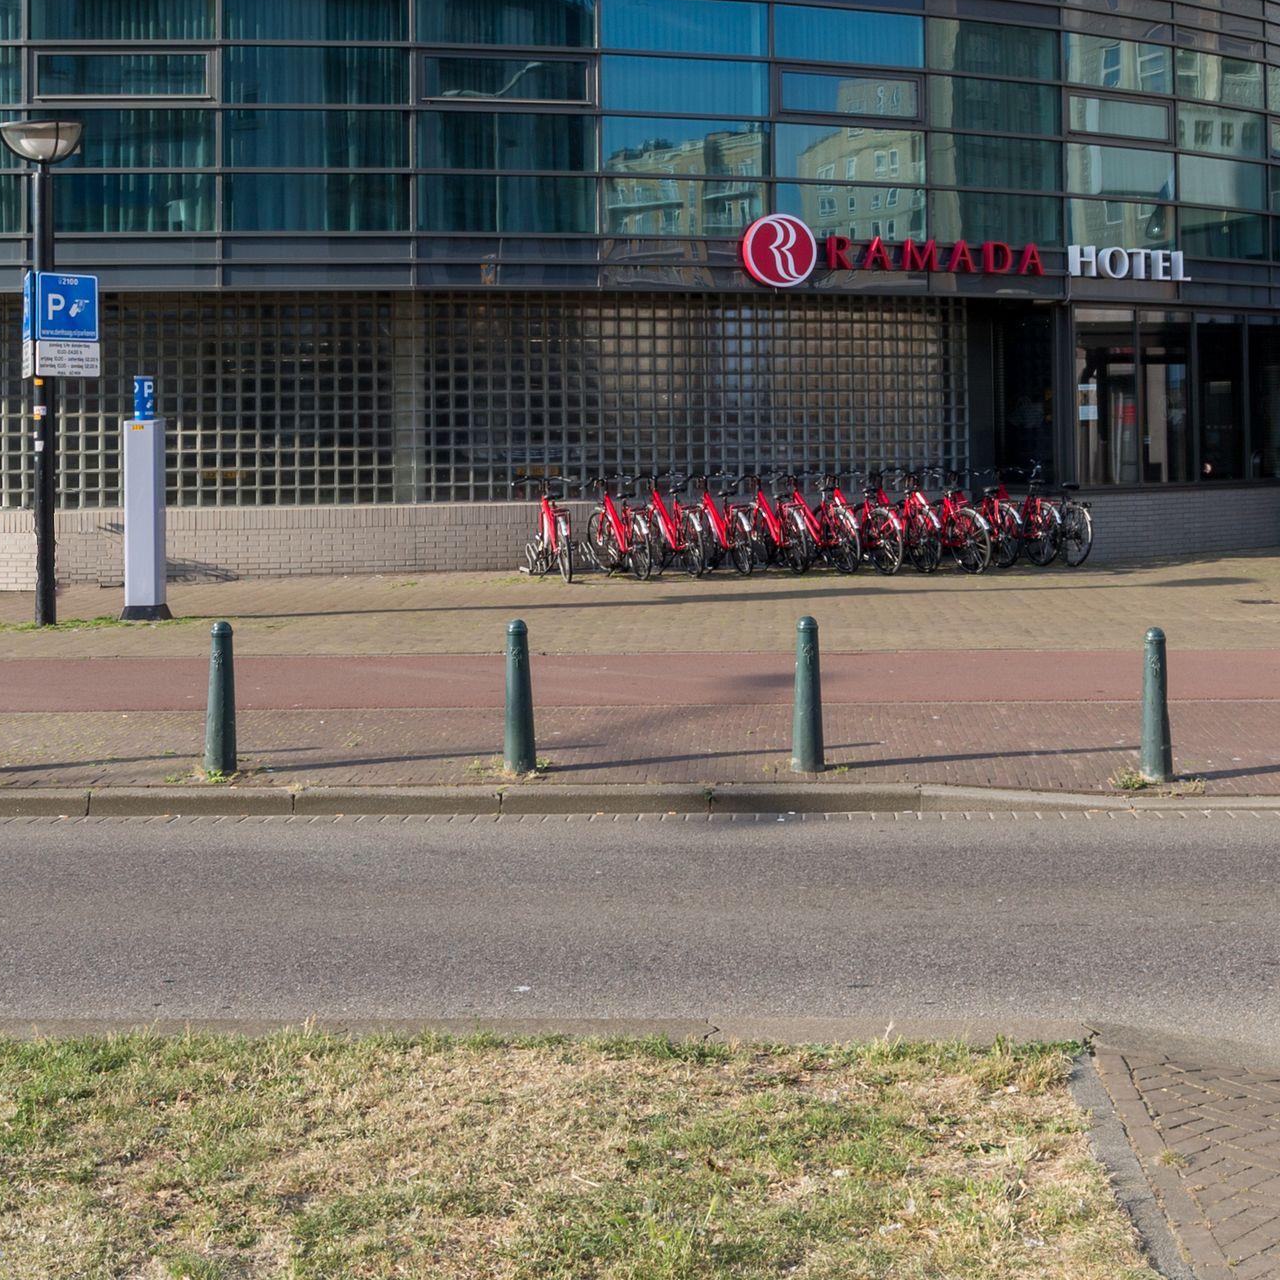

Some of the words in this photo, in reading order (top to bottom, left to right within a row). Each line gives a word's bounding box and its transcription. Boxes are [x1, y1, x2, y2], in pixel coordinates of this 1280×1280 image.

[826, 236, 1046, 276] RAMADA
[1067, 245, 1192, 281] HOTEL
[47, 293, 66, 320] P
[144, 381, 154, 398] P
